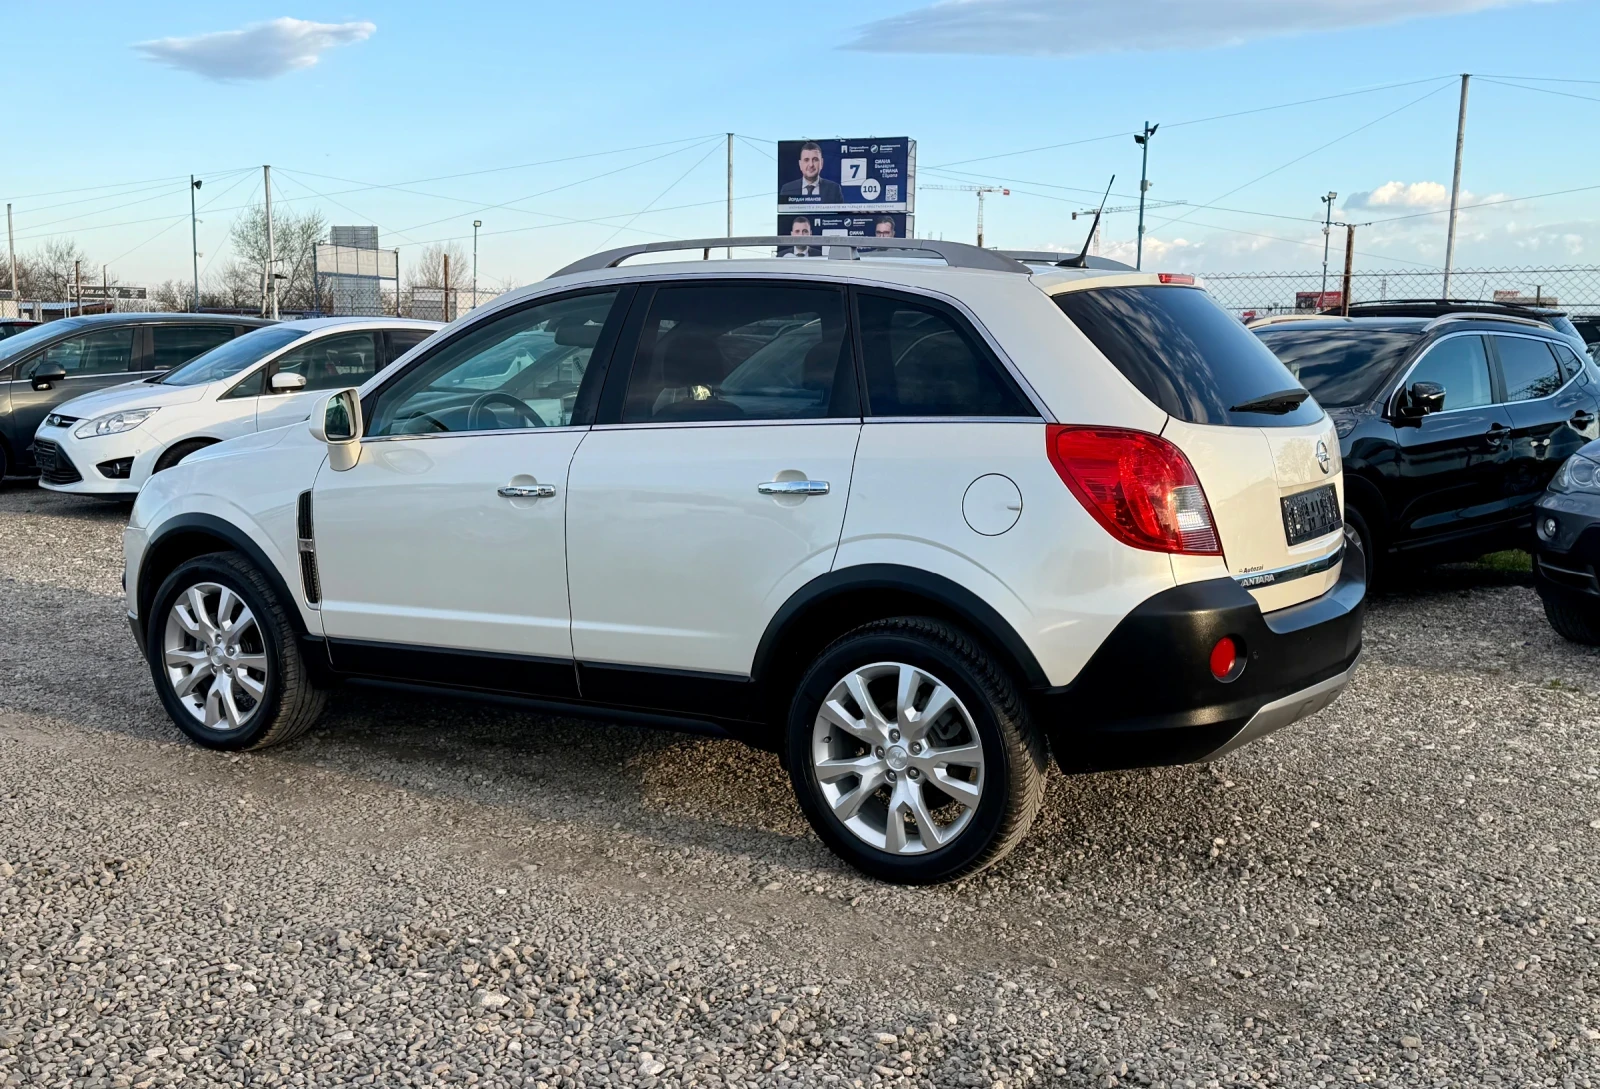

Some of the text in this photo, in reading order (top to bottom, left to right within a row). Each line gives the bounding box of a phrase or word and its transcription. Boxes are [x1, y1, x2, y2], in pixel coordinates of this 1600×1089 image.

[849, 164, 861, 179] 7
[863, 185, 878, 193] 101
[1242, 574, 1275, 587] ANTARA
